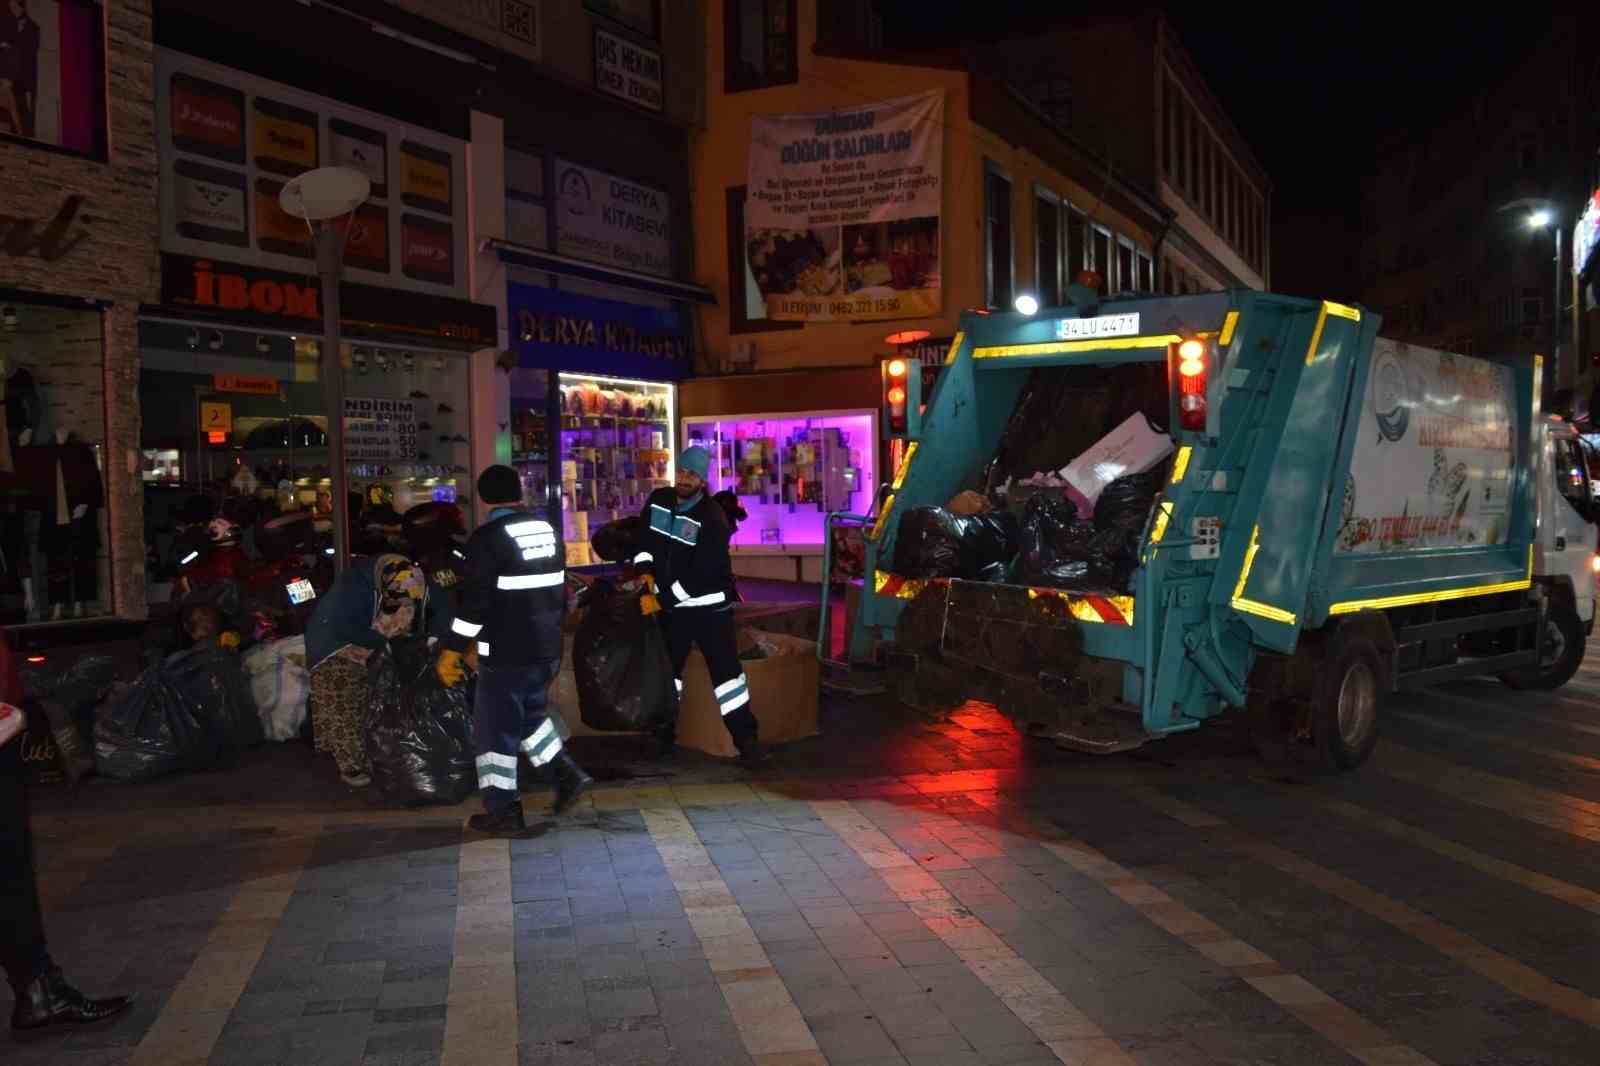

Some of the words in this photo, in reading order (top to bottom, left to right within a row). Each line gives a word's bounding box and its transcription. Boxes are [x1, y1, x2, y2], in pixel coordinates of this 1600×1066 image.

[610, 181, 658, 207] DERYA
[1063, 322, 1078, 335] 34
[1082, 320, 1098, 334] LU
[1102, 317, 1134, 331] 4471
